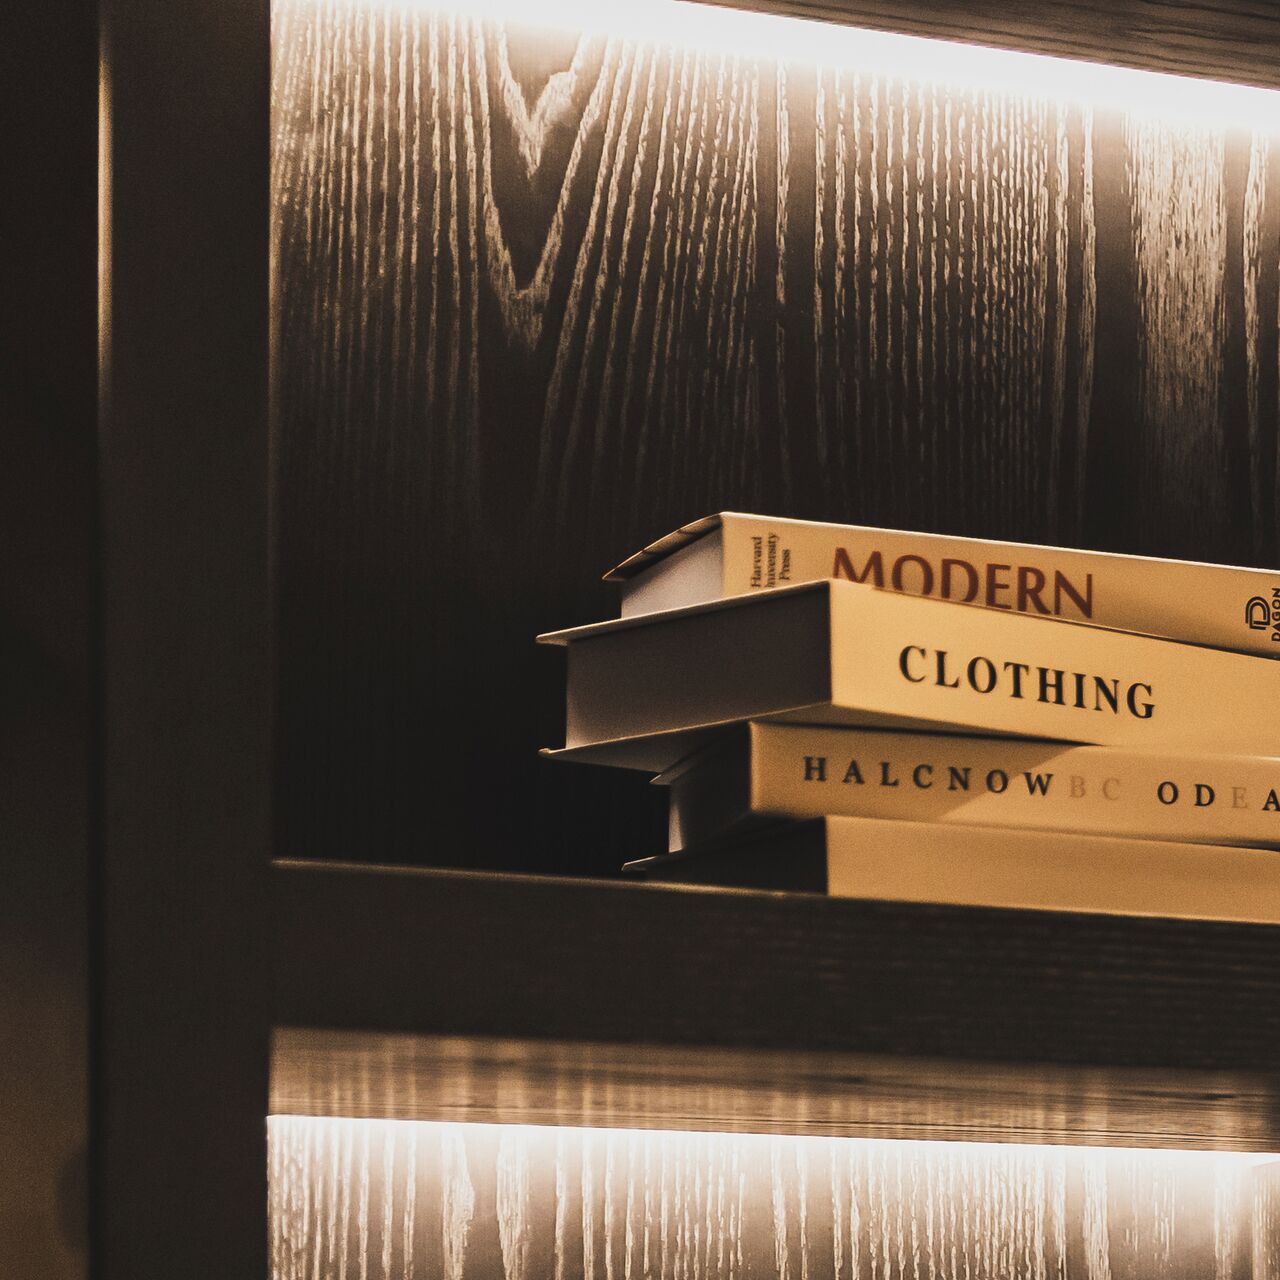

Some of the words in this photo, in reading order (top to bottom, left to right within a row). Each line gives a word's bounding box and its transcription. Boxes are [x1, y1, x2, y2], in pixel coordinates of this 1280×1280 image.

[751, 536, 762, 588] Harvard
[778, 548, 791, 581] Press
[832, 546, 1093, 619] MODERN
[898, 645, 1156, 719] CLOTHING
